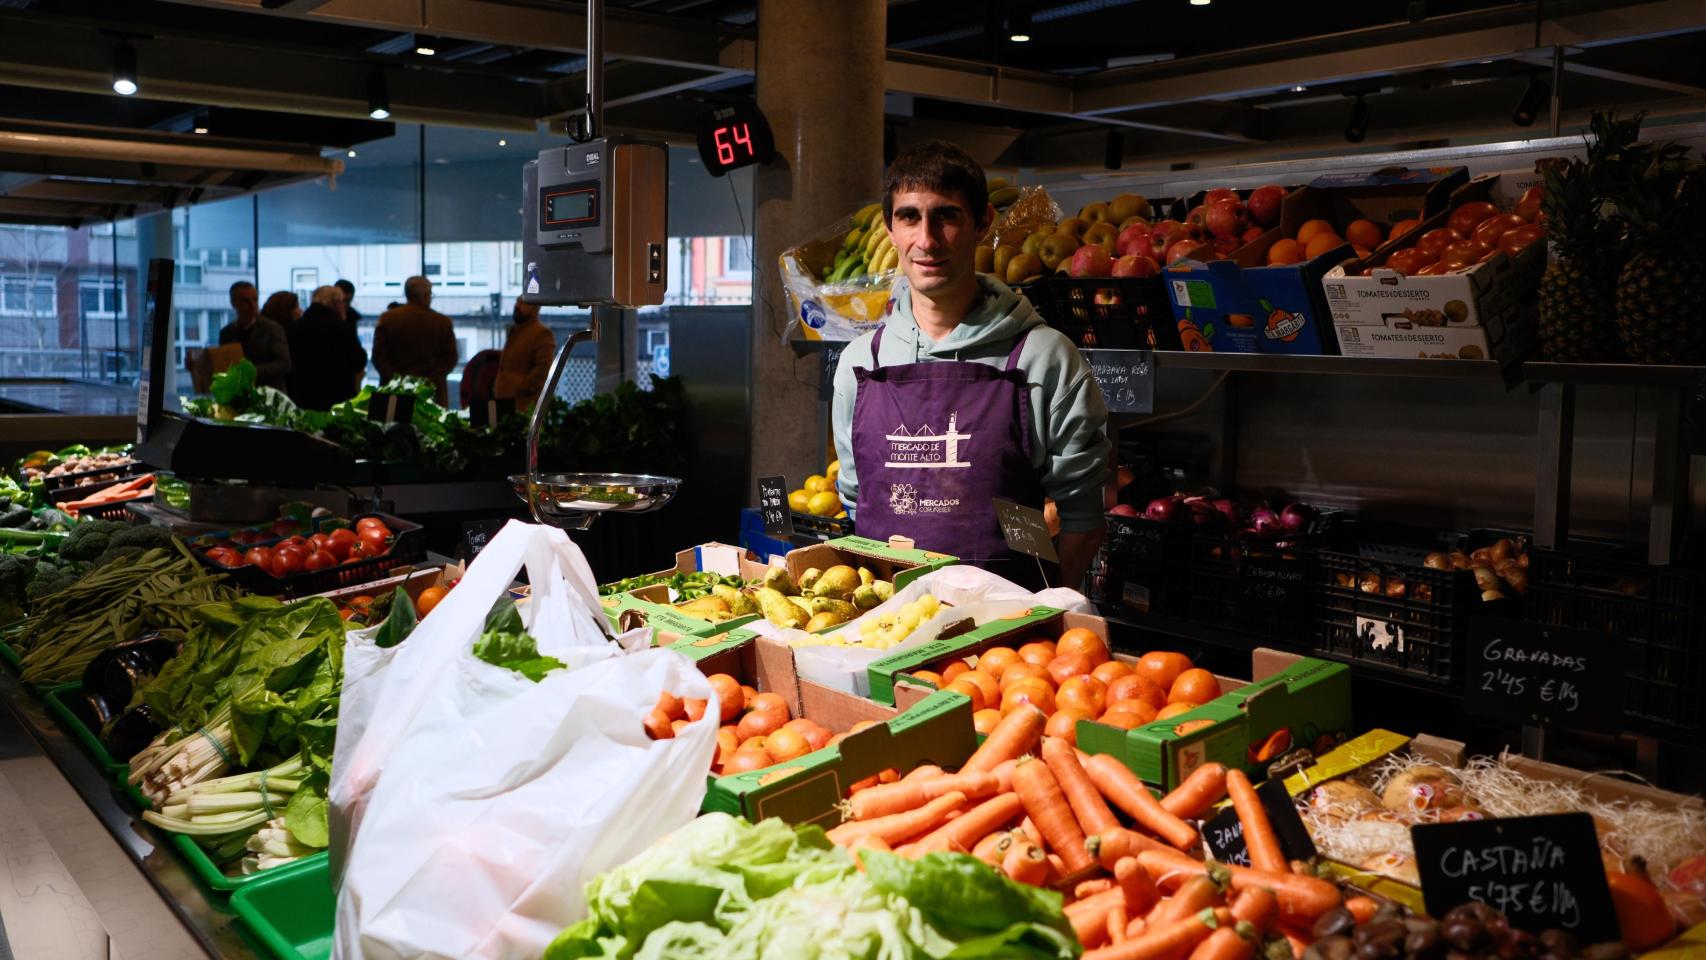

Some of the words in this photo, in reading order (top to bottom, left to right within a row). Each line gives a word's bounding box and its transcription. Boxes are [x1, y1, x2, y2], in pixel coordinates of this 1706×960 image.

[714, 122, 754, 165] 64
[1357, 290, 1390, 298] TOMATES
[1392, 290, 1430, 298] DESIERTO
[1371, 334, 1404, 342] TOMATES
[1407, 334, 1445, 342] DESIERTO
[891, 442, 930, 452] MERCADO
[930, 442, 940, 451] DE
[890, 453, 918, 462] MONTE
[920, 453, 941, 462] ALTO
[919, 498, 960, 507] MERCADOS
[1483, 638, 1587, 672] GRANADAS
[1481, 668, 1527, 696] 2'45
[1440, 835, 1568, 878] CASTAÑA
[1467, 880, 1531, 914] 5'75
